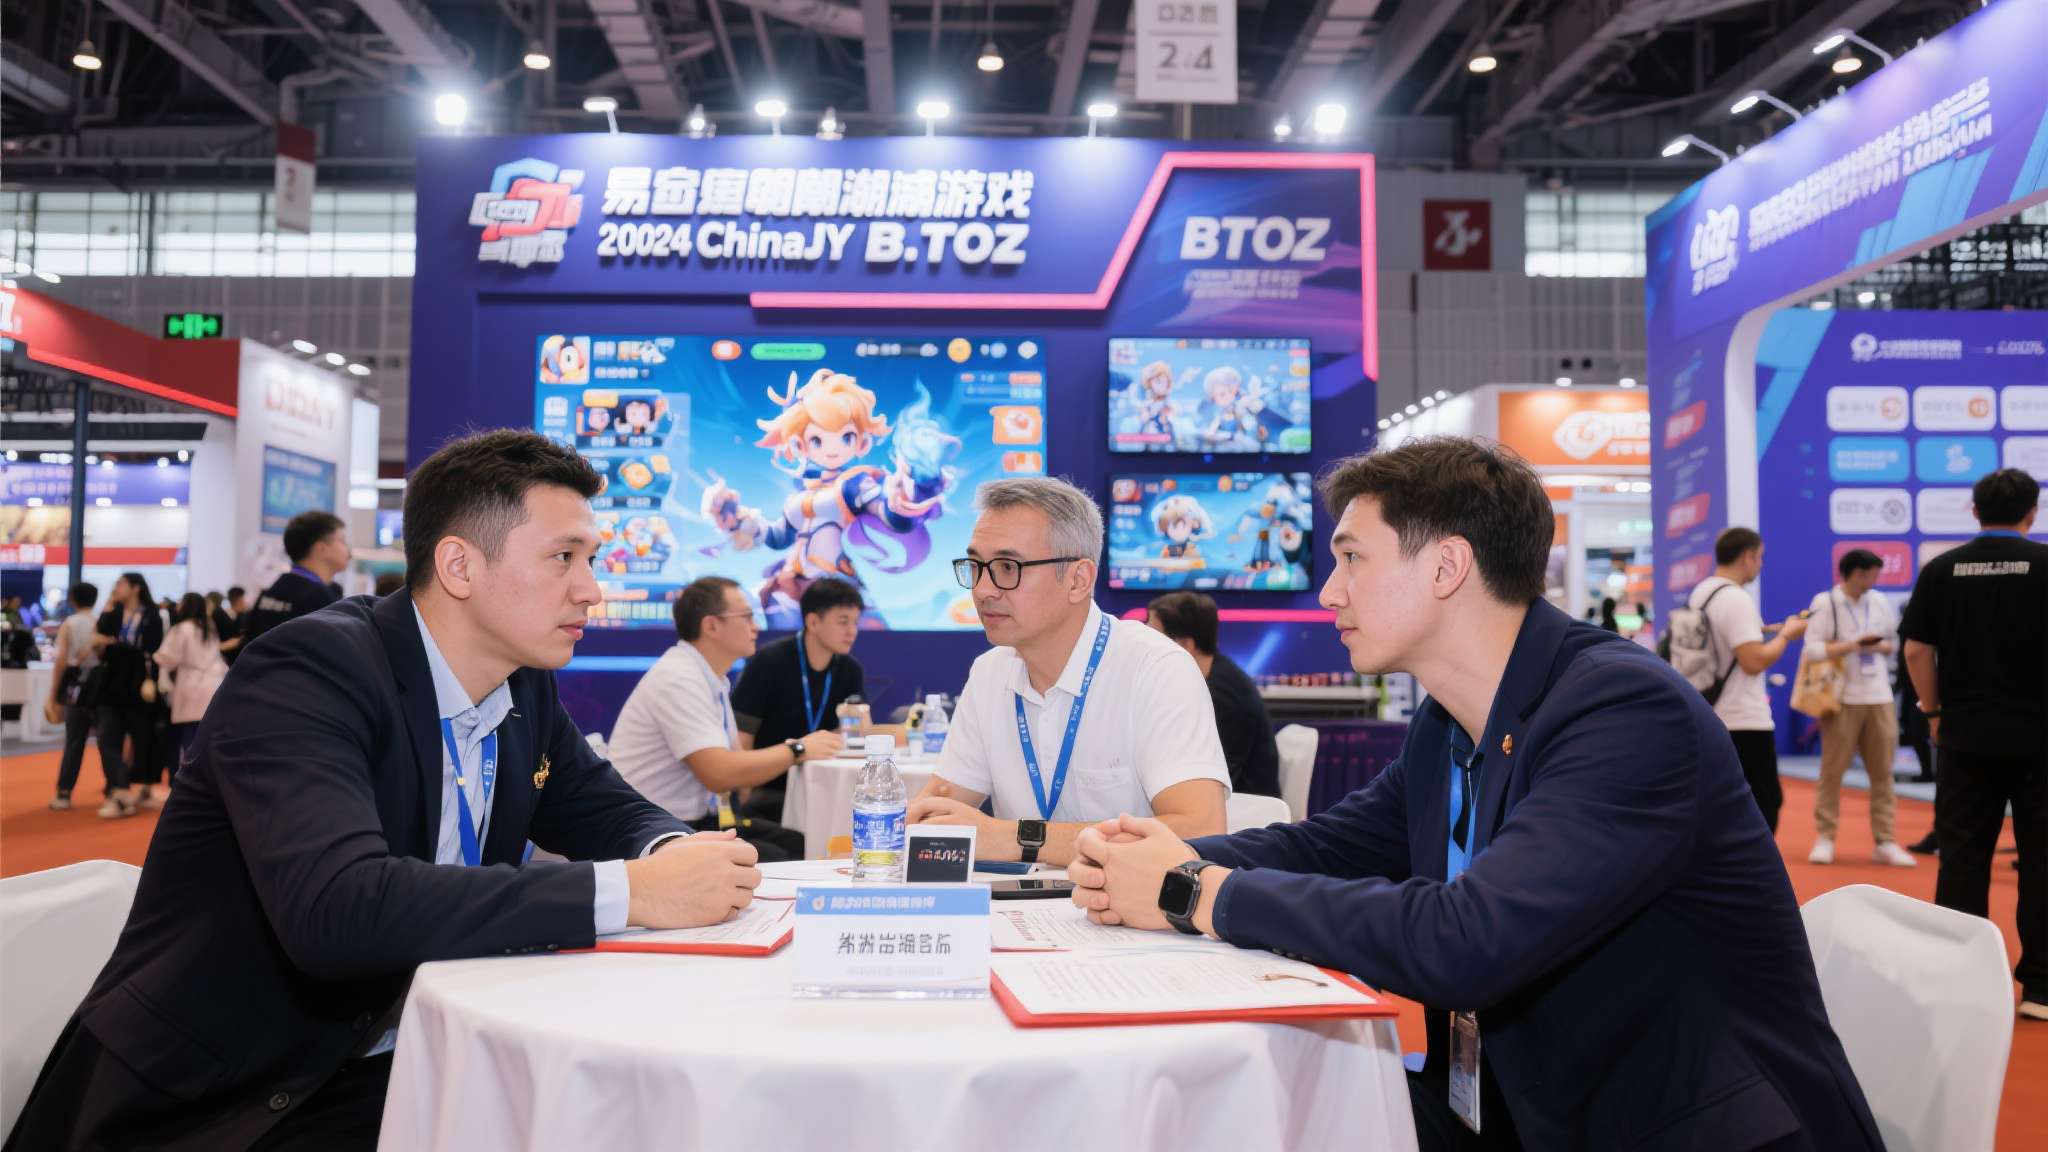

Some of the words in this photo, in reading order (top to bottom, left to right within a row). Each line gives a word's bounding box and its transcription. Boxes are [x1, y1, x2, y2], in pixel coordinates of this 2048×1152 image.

[597, 222, 693, 257] 20024
[697, 221, 856, 261] ChinaJY
[865, 221, 1030, 264] B.TOZ
[1180, 215, 1331, 262] BTOZ
